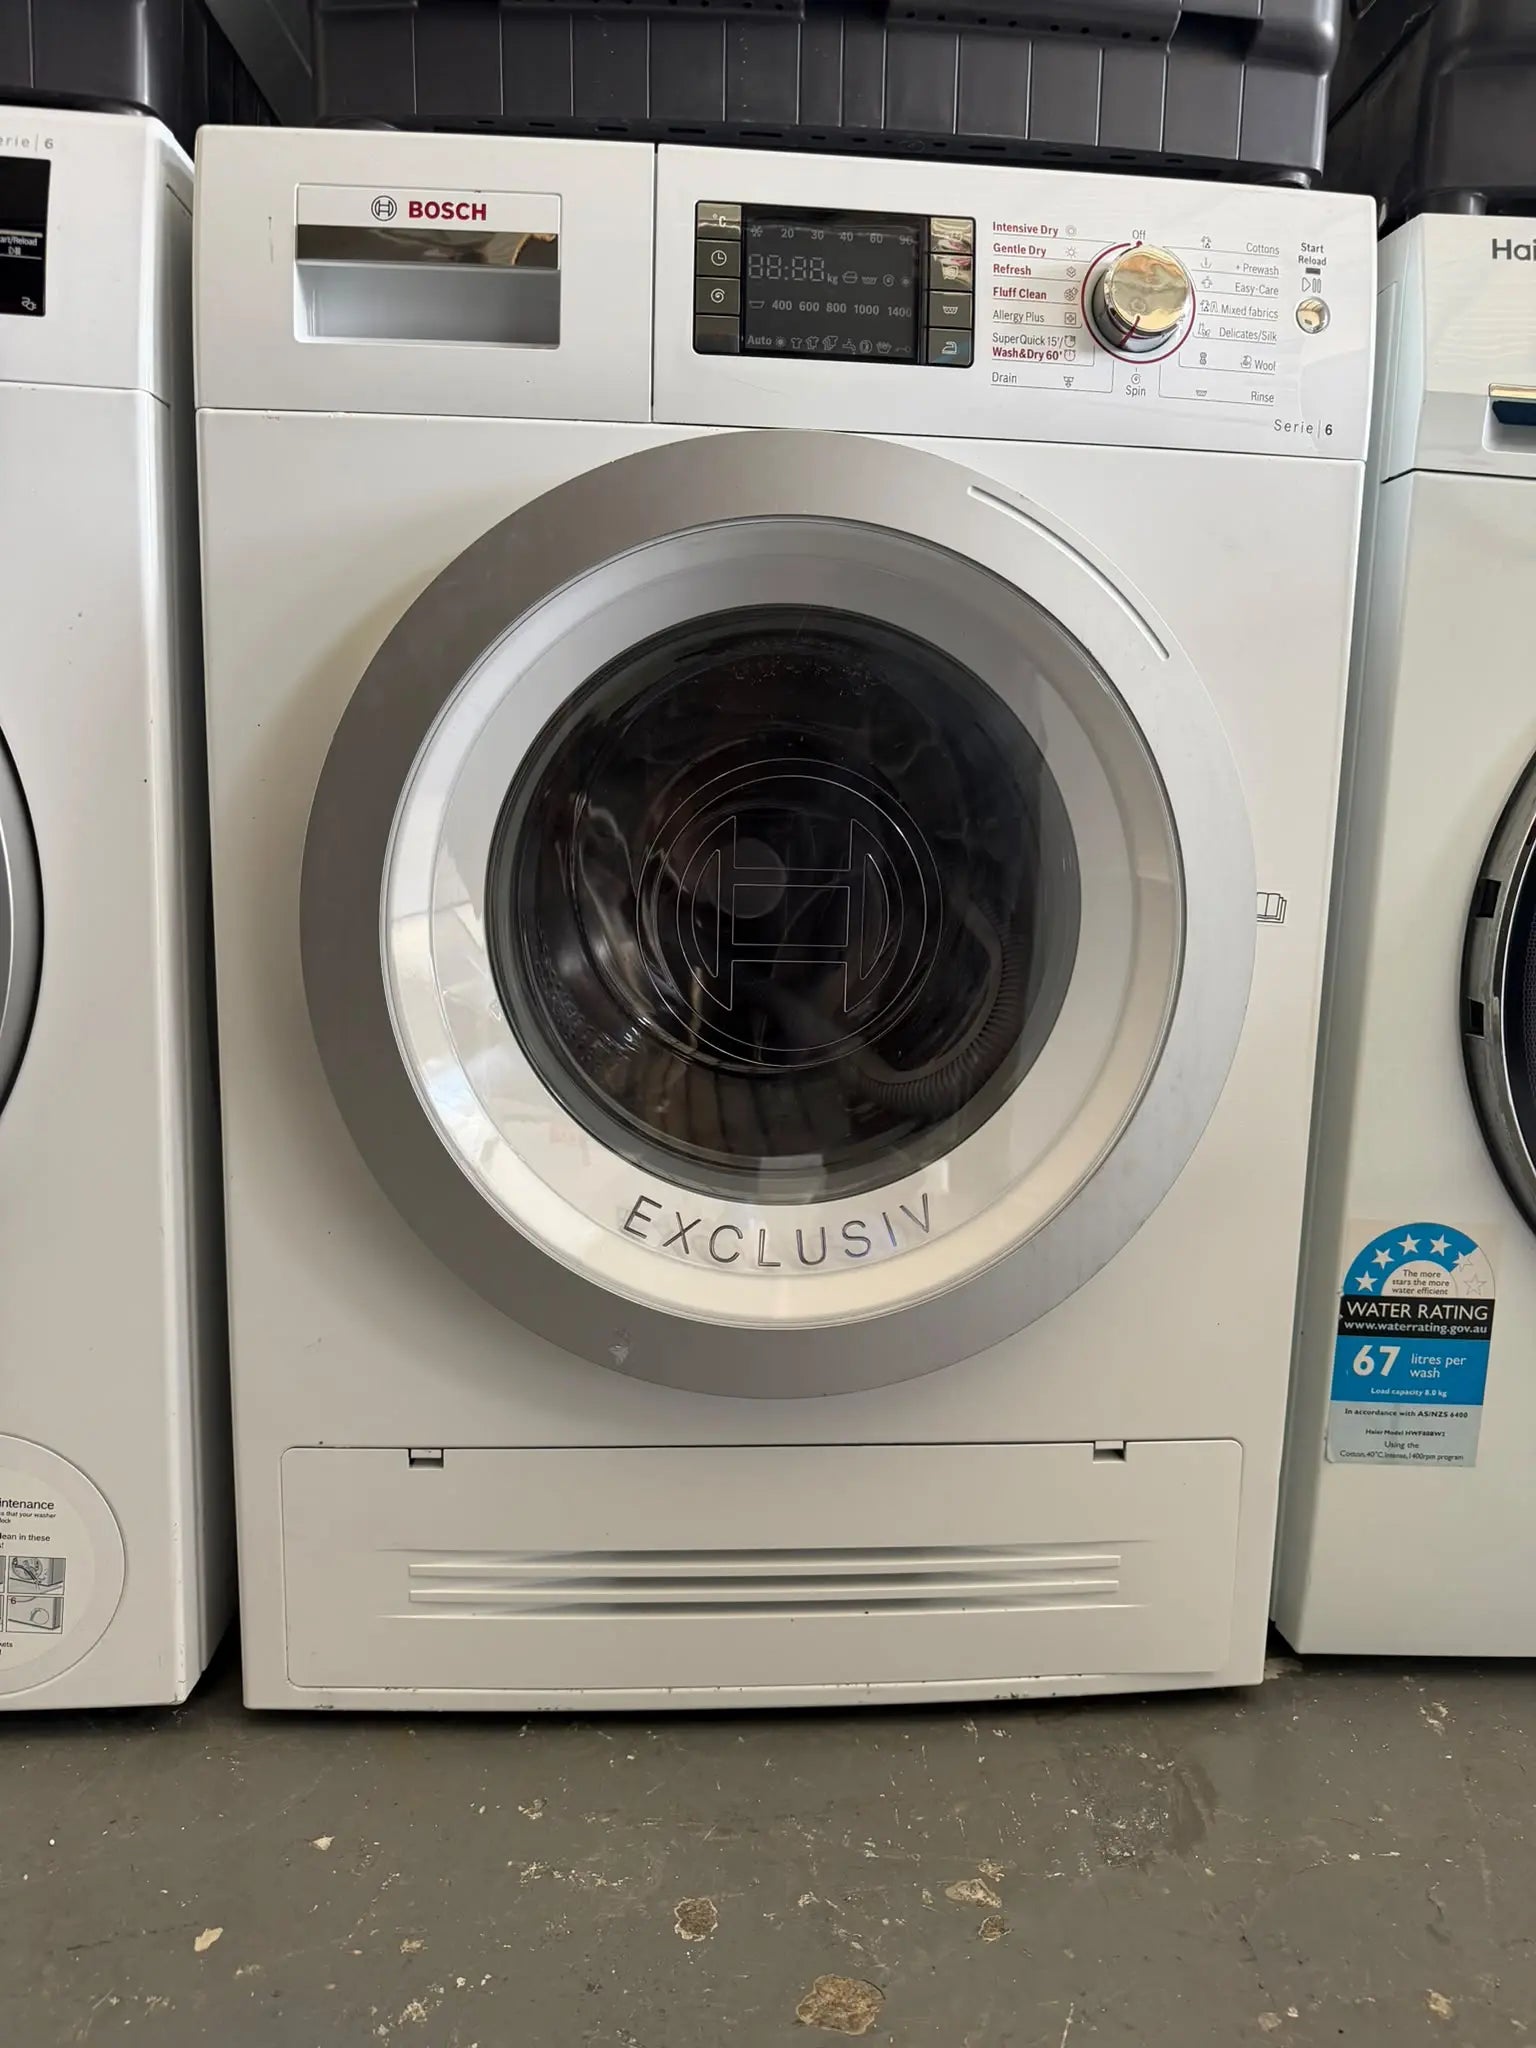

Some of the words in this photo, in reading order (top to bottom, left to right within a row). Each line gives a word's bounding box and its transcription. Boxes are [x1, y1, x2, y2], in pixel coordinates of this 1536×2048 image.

[44, 137, 54, 150] 6
[408, 200, 487, 221] BOSCH
[992, 221, 1039, 235] Intensive
[1040, 224, 1059, 238] Dry
[1132, 229, 1146, 240] Off
[780, 227, 795, 240] 20
[810, 229, 825, 241] 30
[839, 230, 854, 243] 40
[869, 232, 883, 245] 60
[898, 233, 913, 246] 90
[992, 242, 1026, 255] Gentle
[1028, 244, 1047, 258] Dry
[1246, 242, 1280, 256] Cottons
[1300, 242, 1324, 254] Start
[1297, 255, 1327, 267] Reload
[993, 263, 1032, 276] Refresh
[1243, 263, 1279, 276] Prewash
[827, 274, 839, 286] kg
[992, 286, 1017, 299] Fluff
[1018, 288, 1047, 301] Clean
[1235, 281, 1279, 296] Easy-Care
[771, 299, 793, 312] 400
[798, 300, 820, 313] 600
[825, 302, 847, 314] 800
[853, 303, 880, 316] 1000
[887, 304, 912, 318] 1400
[1221, 304, 1248, 317] Mixed
[1248, 306, 1279, 319] fabrics
[992, 309, 1024, 324] Allergy
[1025, 311, 1045, 324] Plus
[747, 334, 772, 347] Auto
[992, 332, 1046, 348] SuperQuick
[1219, 326, 1278, 342] Delicates/Silk
[992, 347, 1044, 362] Wash&Dry
[1045, 350, 1063, 361] 60'
[1254, 361, 1276, 372] Wool
[992, 371, 1018, 384] Drain
[1125, 384, 1146, 398] Spin
[1250, 391, 1275, 403] Rinse
[1273, 418, 1314, 434] Serie
[1324, 424, 1333, 436] 6
[623, 1192, 929, 1267] EXCLUSIV
[1403, 1269, 1418, 1278] The
[1420, 1271, 1441, 1279] more
[1392, 1278, 1411, 1287] stars
[1413, 1278, 1427, 1287] the
[1428, 1280, 1450, 1288] more
[1392, 1287, 1415, 1295] water
[1417, 1286, 1448, 1296] efficient
[1346, 1301, 1412, 1319] WATER
[1417, 1304, 1489, 1322] RATING
[1344, 1320, 1488, 1336] www.waterrating.gov.au
[1352, 1344, 1401, 1377] 67
[1410, 1353, 1442, 1366] litres
[1445, 1357, 1467, 1369] per
[1409, 1367, 1441, 1378] wash
[1370, 1387, 1390, 1396] Load
[1391, 1388, 1423, 1398] capacity
[1438, 1390, 1448, 1399] kg
[1344, 1408, 1353, 1416] In
[1354, 1409, 1398, 1417] accordance
[1399, 1410, 1417, 1418] with
[1450, 1411, 1469, 1419] 6400
[1384, 1440, 1405, 1450] Using
[1407, 1442, 1420, 1450] the
[1436, 1454, 1464, 1463] program
[19, 1533, 26, 1541] in
[28, 1533, 51, 1542] these
[11, 1596, 17, 1605] 6
